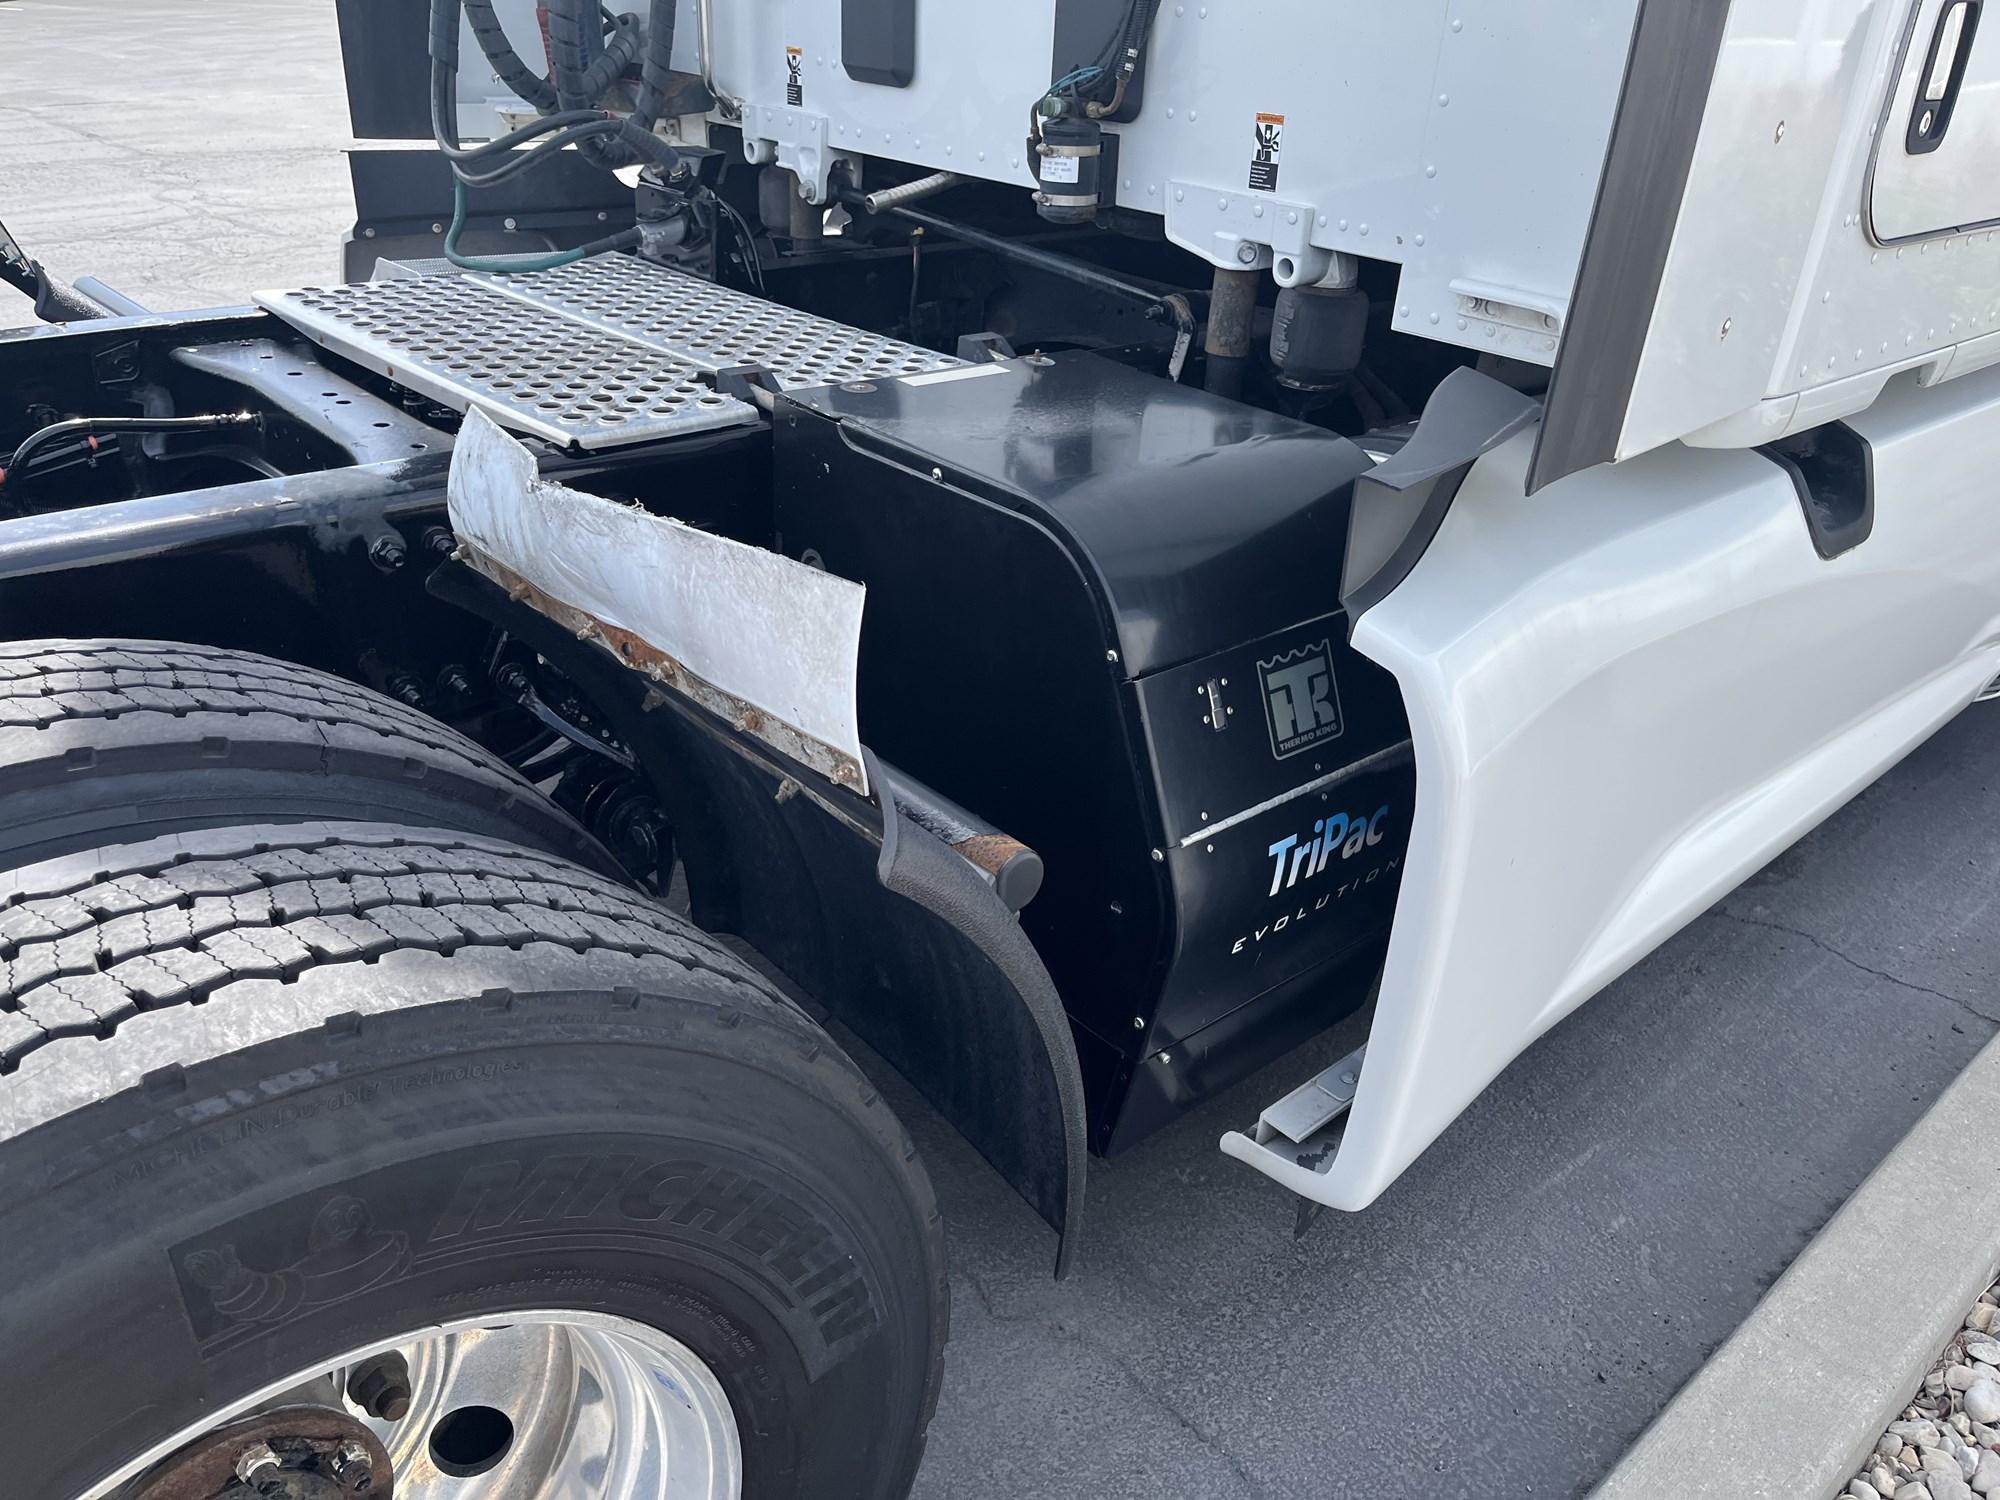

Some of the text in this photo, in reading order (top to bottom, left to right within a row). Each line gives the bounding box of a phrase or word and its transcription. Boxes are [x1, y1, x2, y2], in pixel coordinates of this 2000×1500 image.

[1279, 722, 1337, 752] THERMO KING
[1269, 805, 1389, 897] TriPac
[1232, 857, 1399, 954] EVOLUTION
[430, 1152, 877, 1346] MICHELIN
